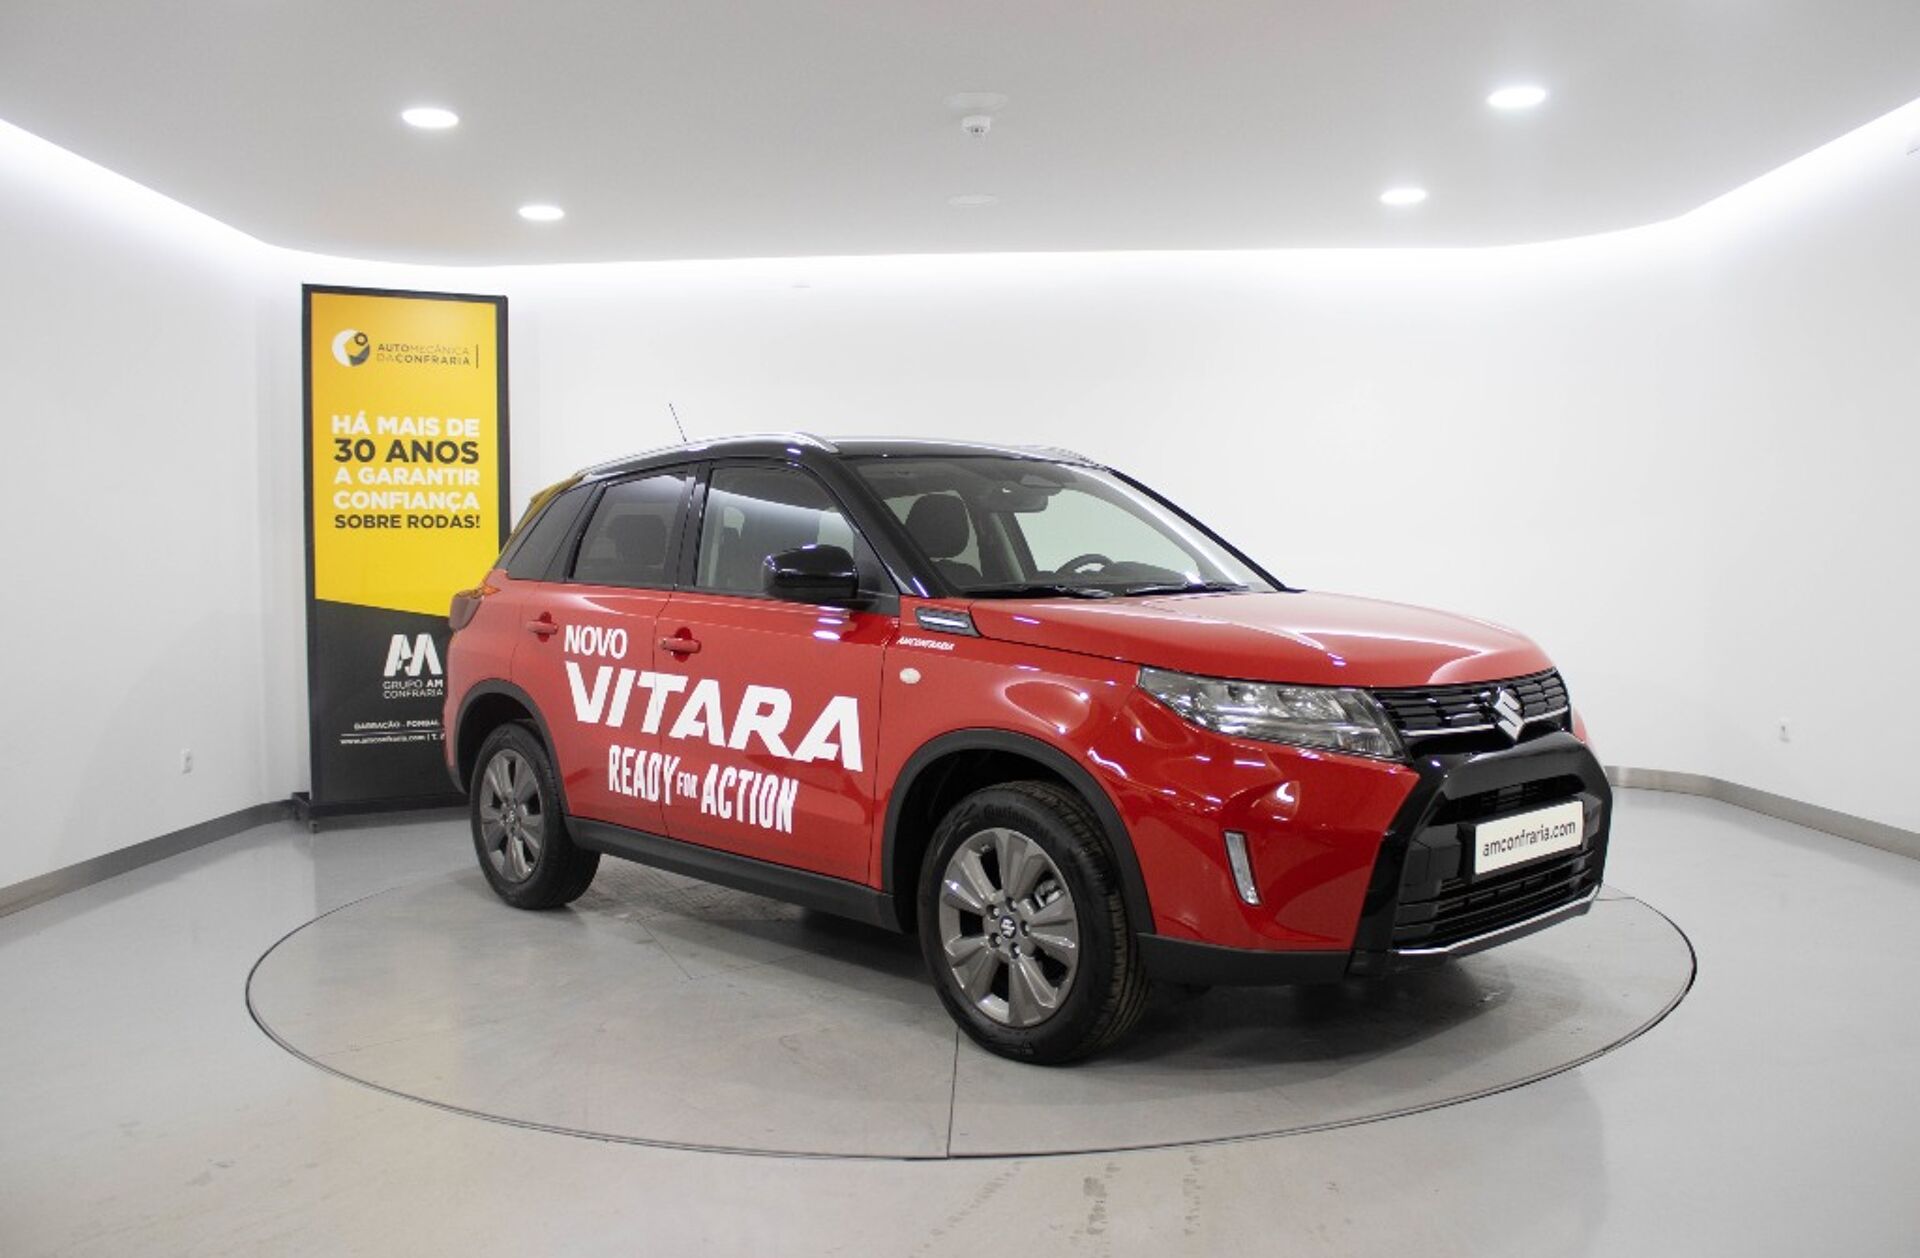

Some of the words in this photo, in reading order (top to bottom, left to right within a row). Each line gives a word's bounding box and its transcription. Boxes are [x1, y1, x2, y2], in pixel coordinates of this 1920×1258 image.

[331, 410, 371, 435] HÁ
[377, 416, 440, 436] MAIS
[446, 418, 480, 437] DE
[334, 438, 376, 463] 30
[385, 439, 479, 464] ANOS
[334, 466, 352, 485] A
[358, 467, 480, 486] GARANTIR
[333, 491, 480, 512] CONFIANÇA
[334, 514, 402, 529] SOBRE
[407, 514, 480, 529] RODAS!
[564, 624, 628, 660] NOVO
[382, 680, 423, 690] GRUPO
[426, 679, 443, 688] AM
[383, 689, 443, 699] CONFRARIA
[565, 660, 864, 772] VITARA
[608, 744, 682, 806] READY
[676, 771, 698, 799] FOR
[700, 763, 798, 834] ACTION
[1482, 821, 1576, 857] amconfraria.com
